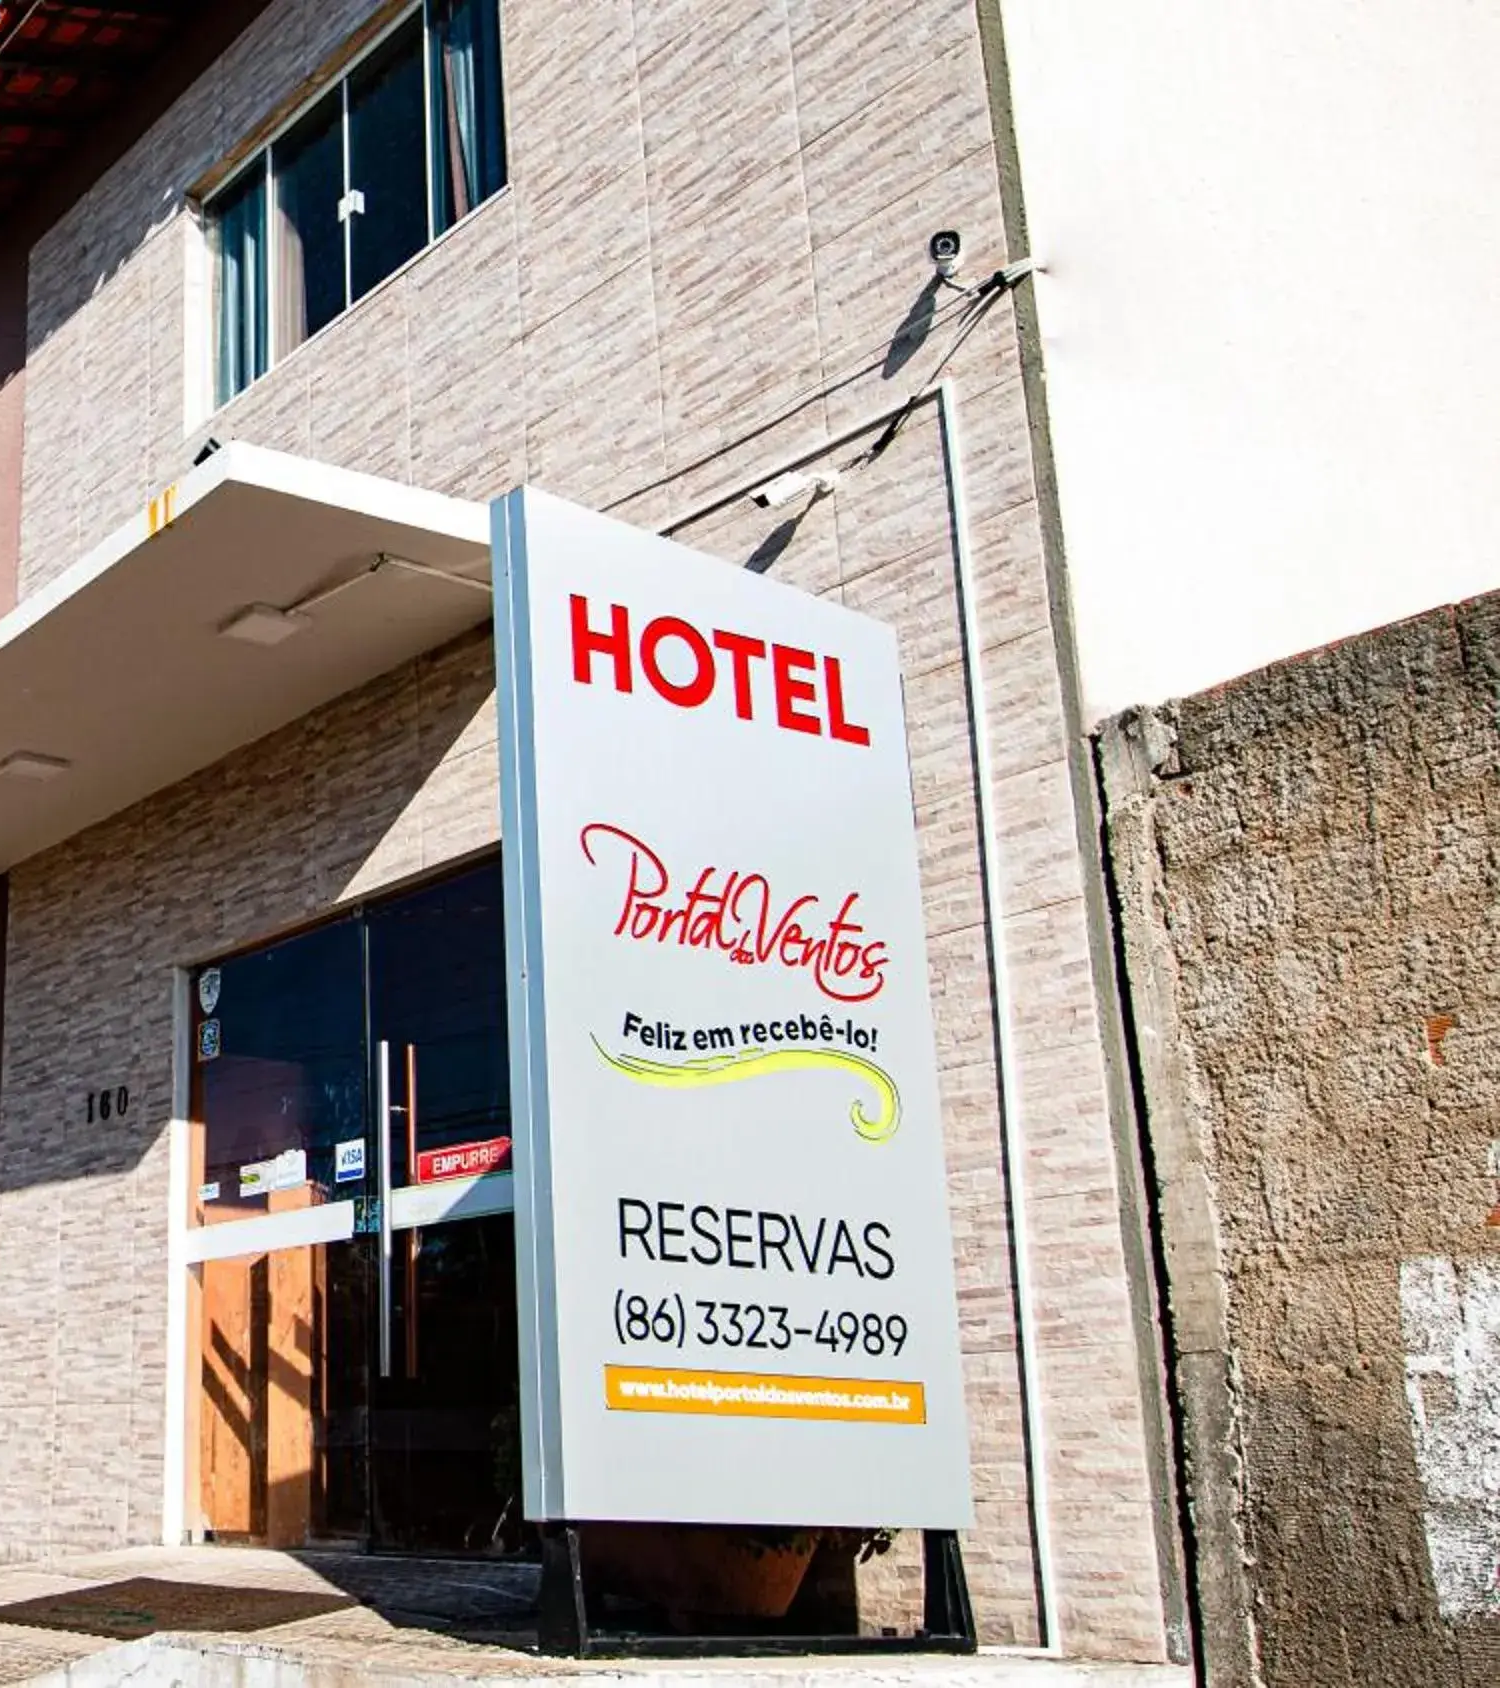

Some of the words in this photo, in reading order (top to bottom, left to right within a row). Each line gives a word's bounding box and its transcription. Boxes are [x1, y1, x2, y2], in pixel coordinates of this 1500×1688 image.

[569, 593, 871, 747] HOTEL
[580, 823, 738, 951] Portal
[731, 873, 889, 1002] Ventos
[622, 1011, 688, 1051] Feliz
[693, 1025, 735, 1049] em
[740, 1013, 879, 1053] recebê-lo!
[431, 1146, 500, 1176] EMPURRE
[617, 1196, 896, 1281] RESERVAS
[613, 1288, 685, 1348] (86)
[694, 1299, 908, 1357] 3323-4989
